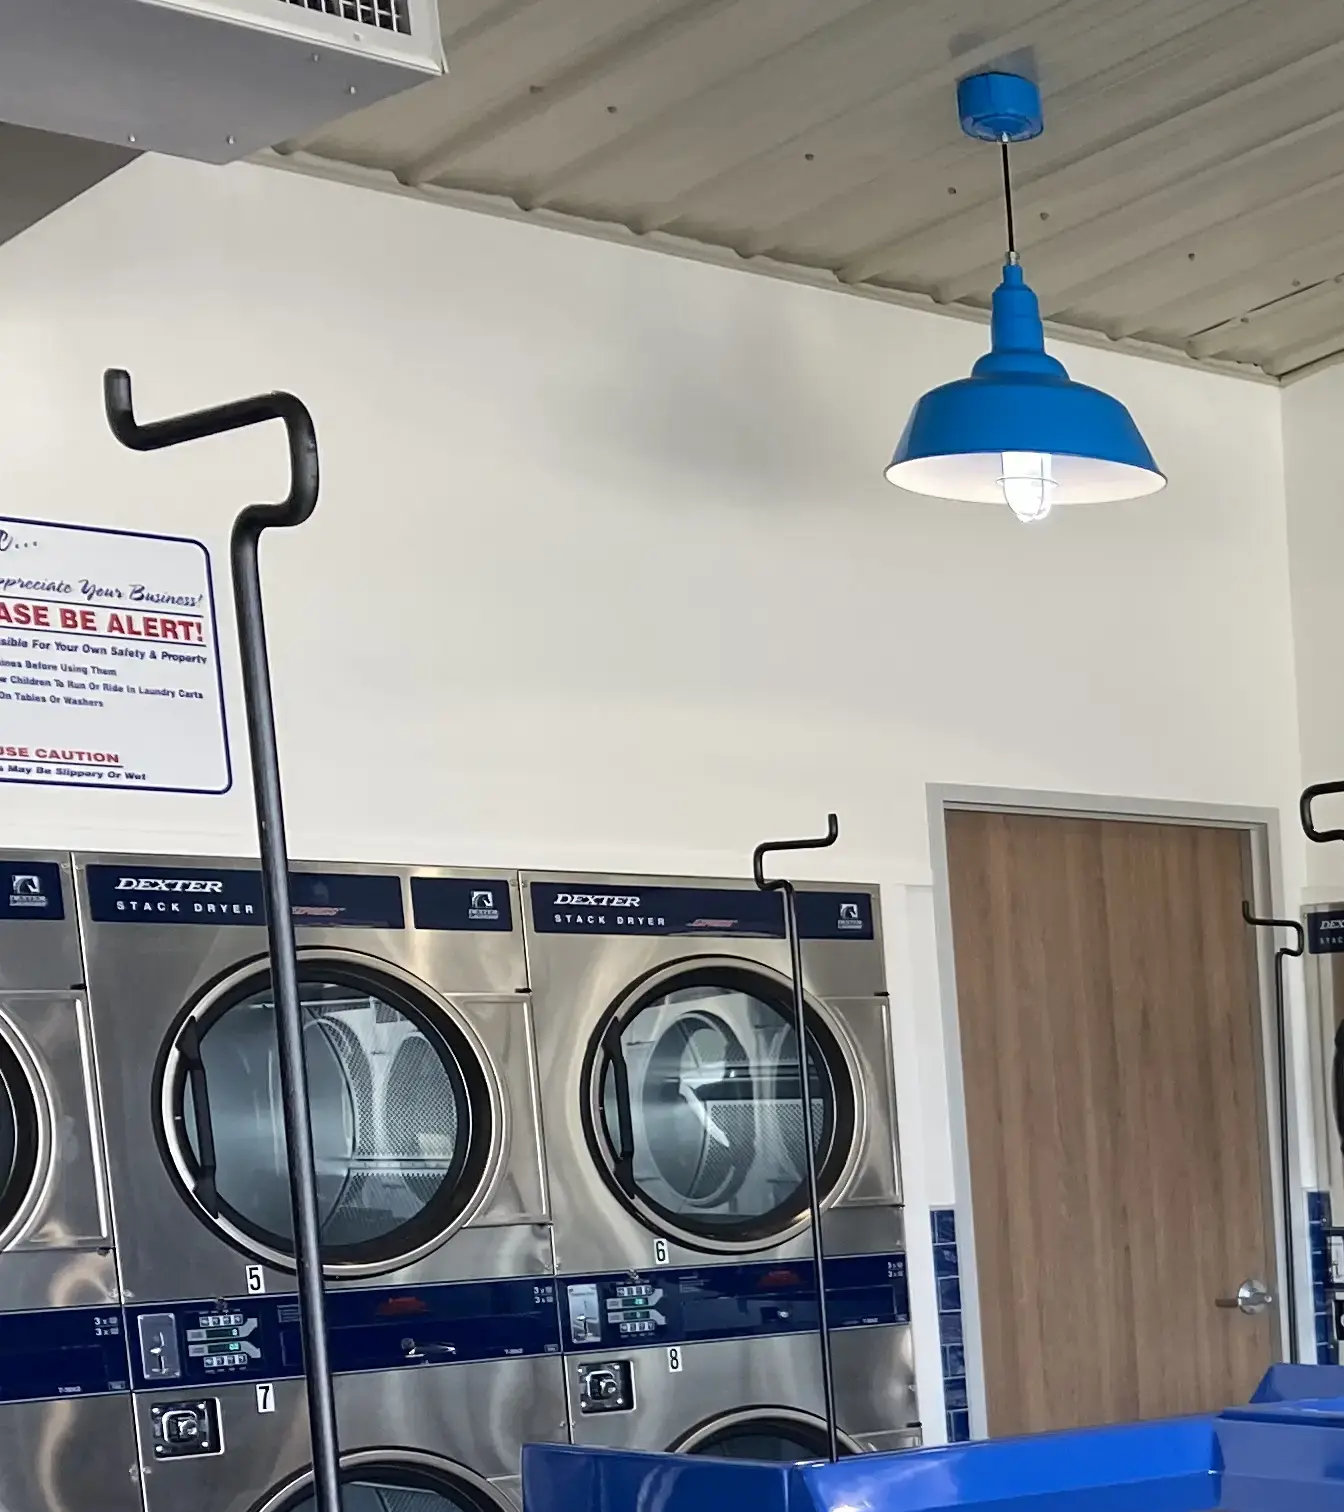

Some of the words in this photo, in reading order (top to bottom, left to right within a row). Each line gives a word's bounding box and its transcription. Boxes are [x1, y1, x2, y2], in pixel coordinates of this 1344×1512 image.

[78, 579, 124, 600] Your
[129, 584, 203, 606] Business!
[59, 607, 97, 631] BE
[107, 613, 204, 642] ALERT!
[32, 639, 51, 650] For
[54, 641, 78, 653] Your
[82, 643, 107, 655] Own
[111, 646, 146, 660] Safety
[161, 651, 207, 665] Property
[10, 676, 52, 687] Children
[35, 748, 119, 763] CAUTION
[114, 877, 223, 893] DEXTER
[116, 901, 180, 912] STACK
[194, 903, 254, 914] DRYER
[553, 893, 640, 907] DEXTER
[554, 914, 606, 924] STACK
[617, 916, 665, 926] DRYER
[655, 1241, 665, 1262] 6
[249, 1267, 261, 1291] 5
[669, 1348, 680, 1370] 8
[258, 1386, 270, 1410] 7
